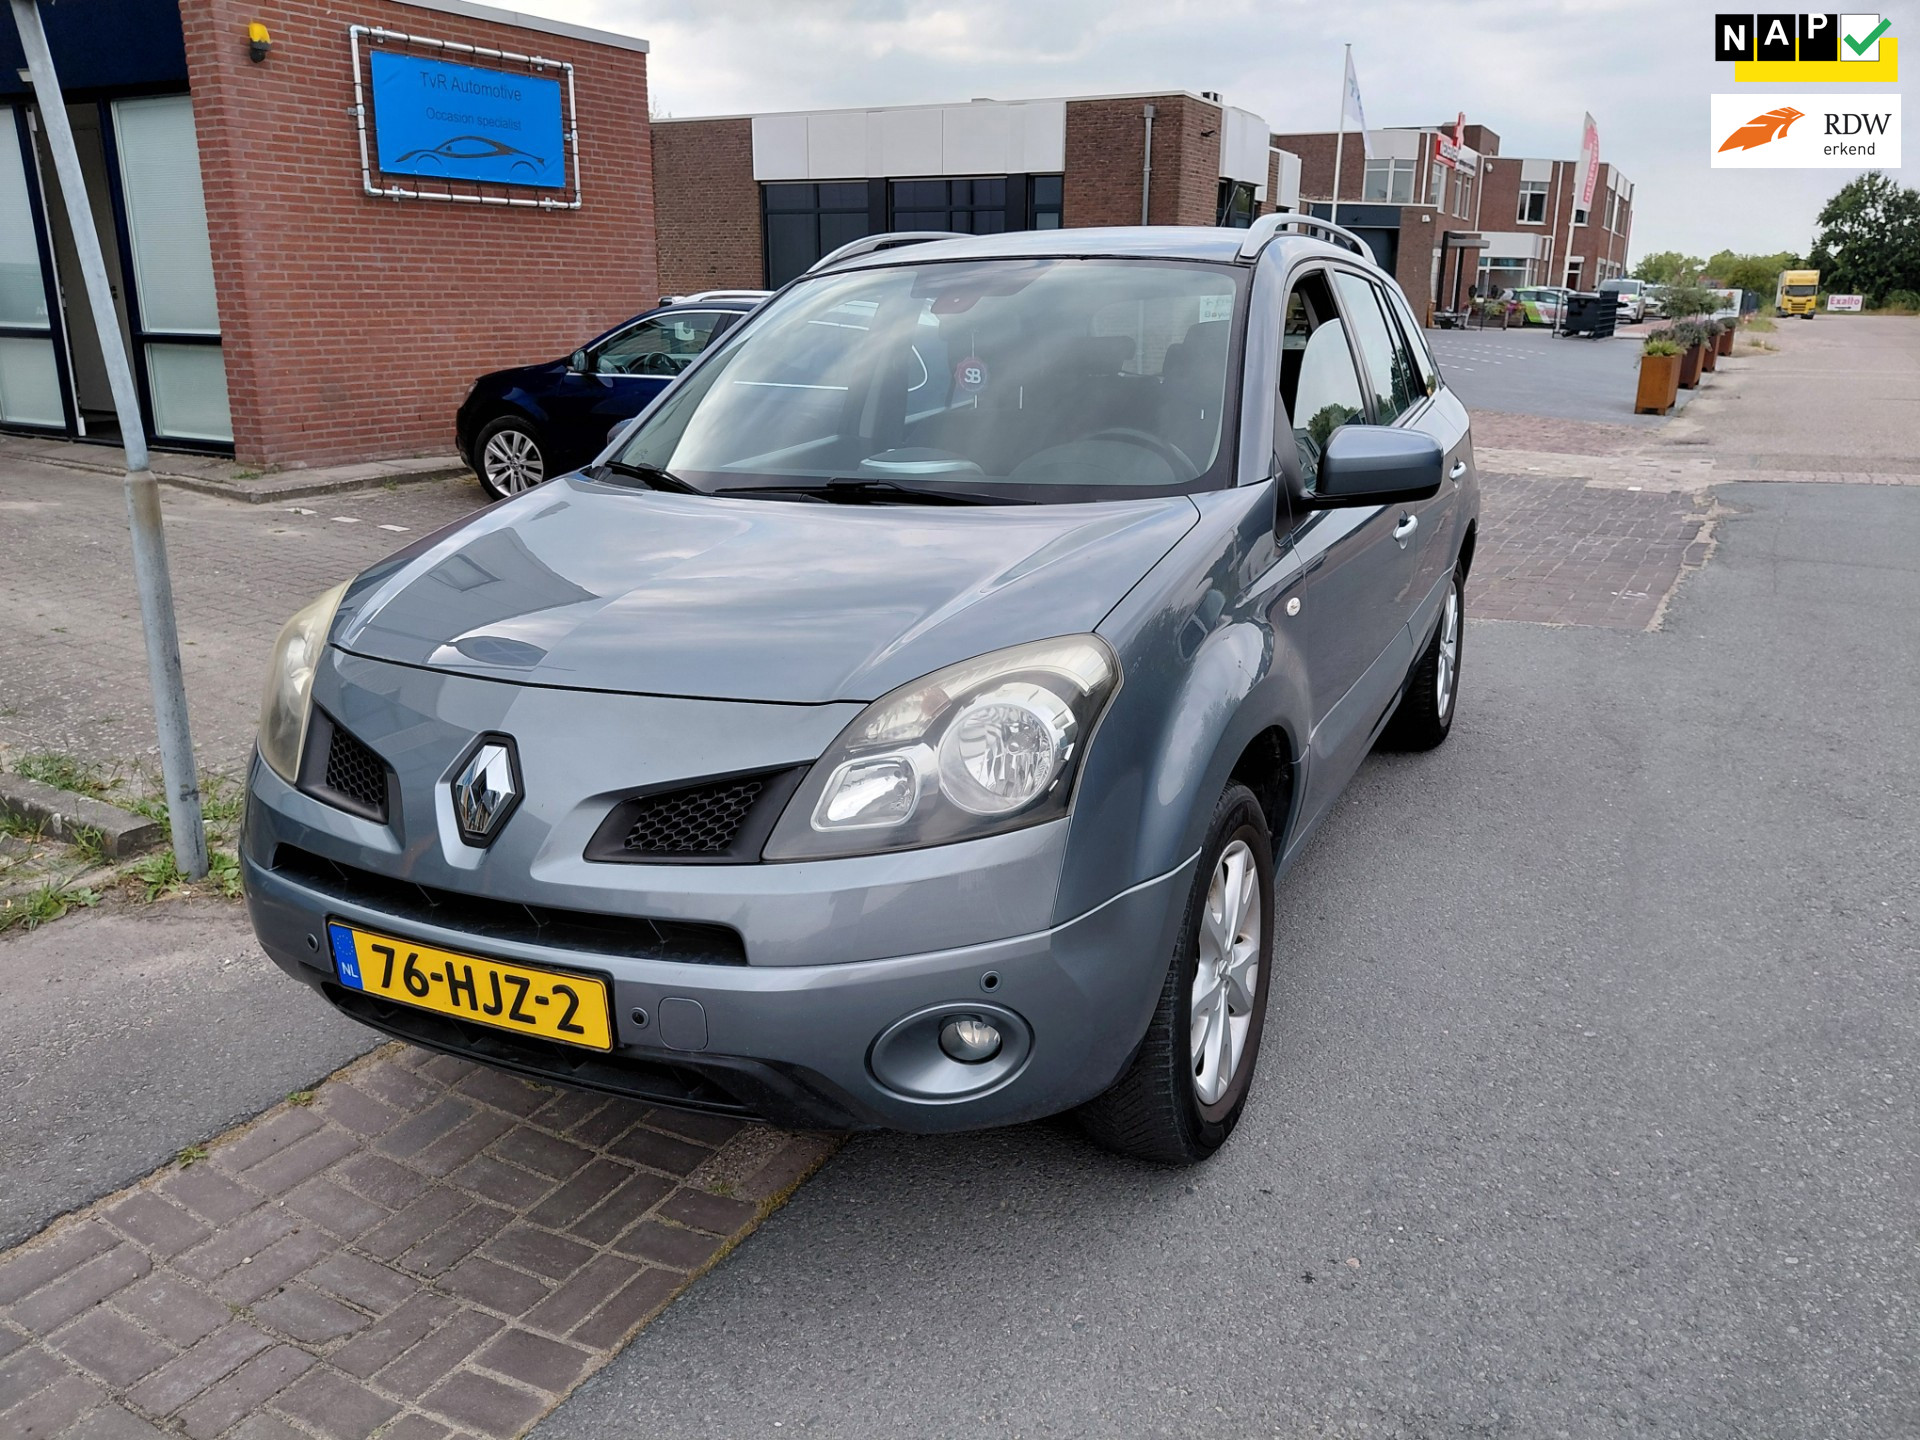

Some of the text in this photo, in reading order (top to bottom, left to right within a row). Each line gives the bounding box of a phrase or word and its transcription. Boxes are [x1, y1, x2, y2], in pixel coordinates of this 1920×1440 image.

[420, 71, 522, 101] TvR Automotive
[426, 106, 522, 131] Occasion specialist
[341, 961, 359, 979] NL
[371, 943, 585, 1035] 76-HJZ-2
